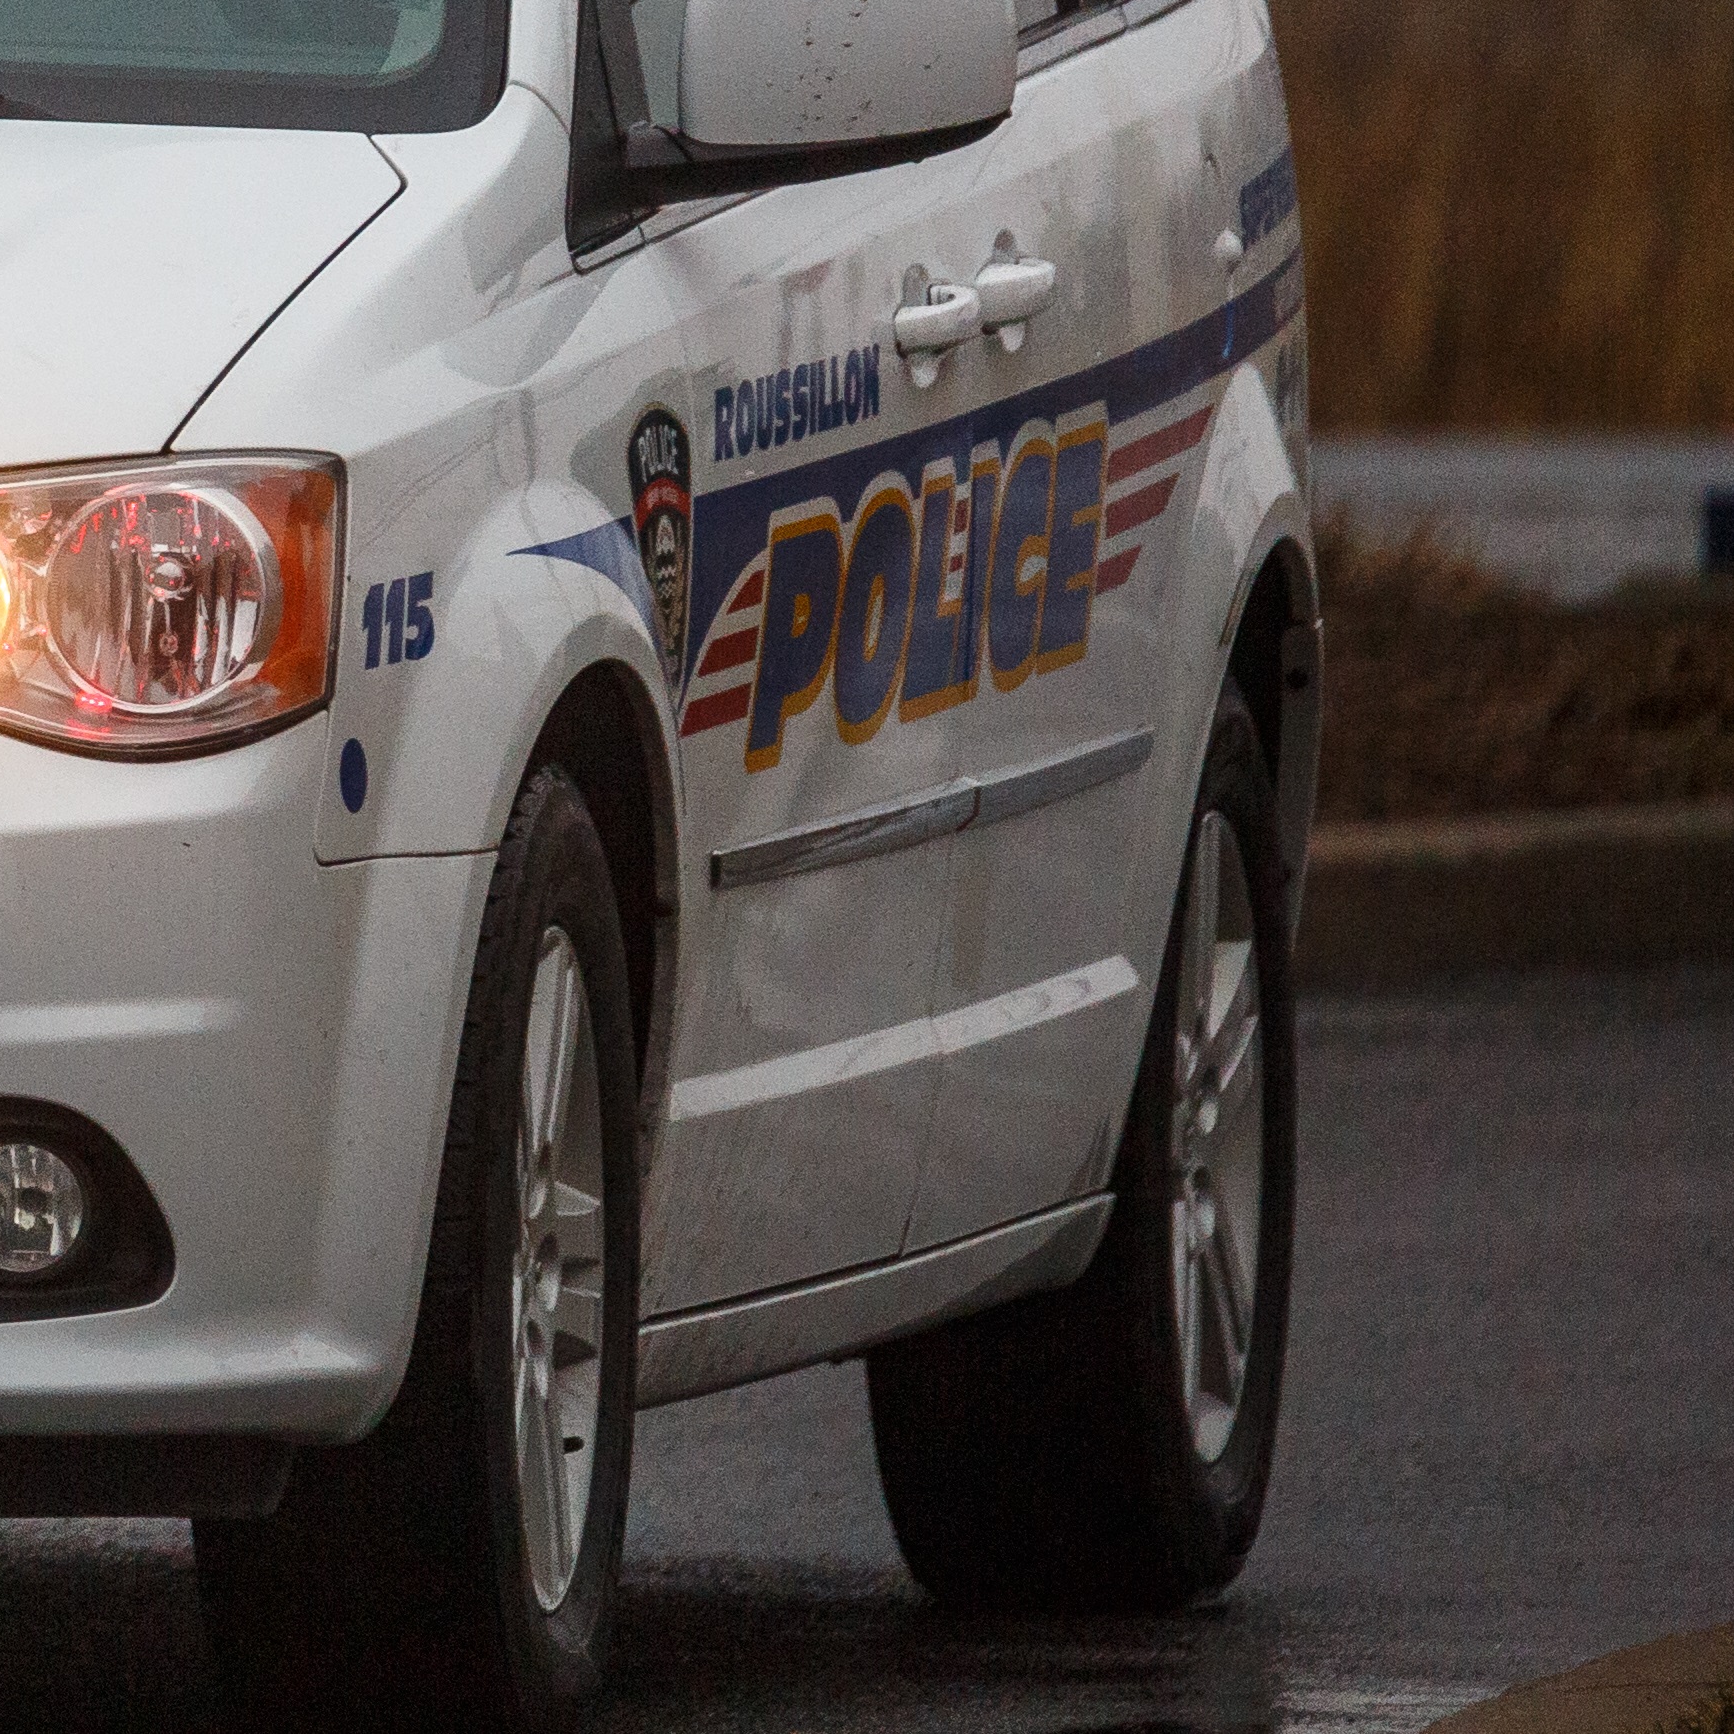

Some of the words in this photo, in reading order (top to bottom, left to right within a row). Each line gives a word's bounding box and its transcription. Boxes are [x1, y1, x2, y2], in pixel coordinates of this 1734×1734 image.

[638, 424, 679, 483] POLICE
[714, 344, 880, 461] ROUSSILLON
[361, 569, 436, 670] 115
[744, 403, 1110, 773] POLICE
